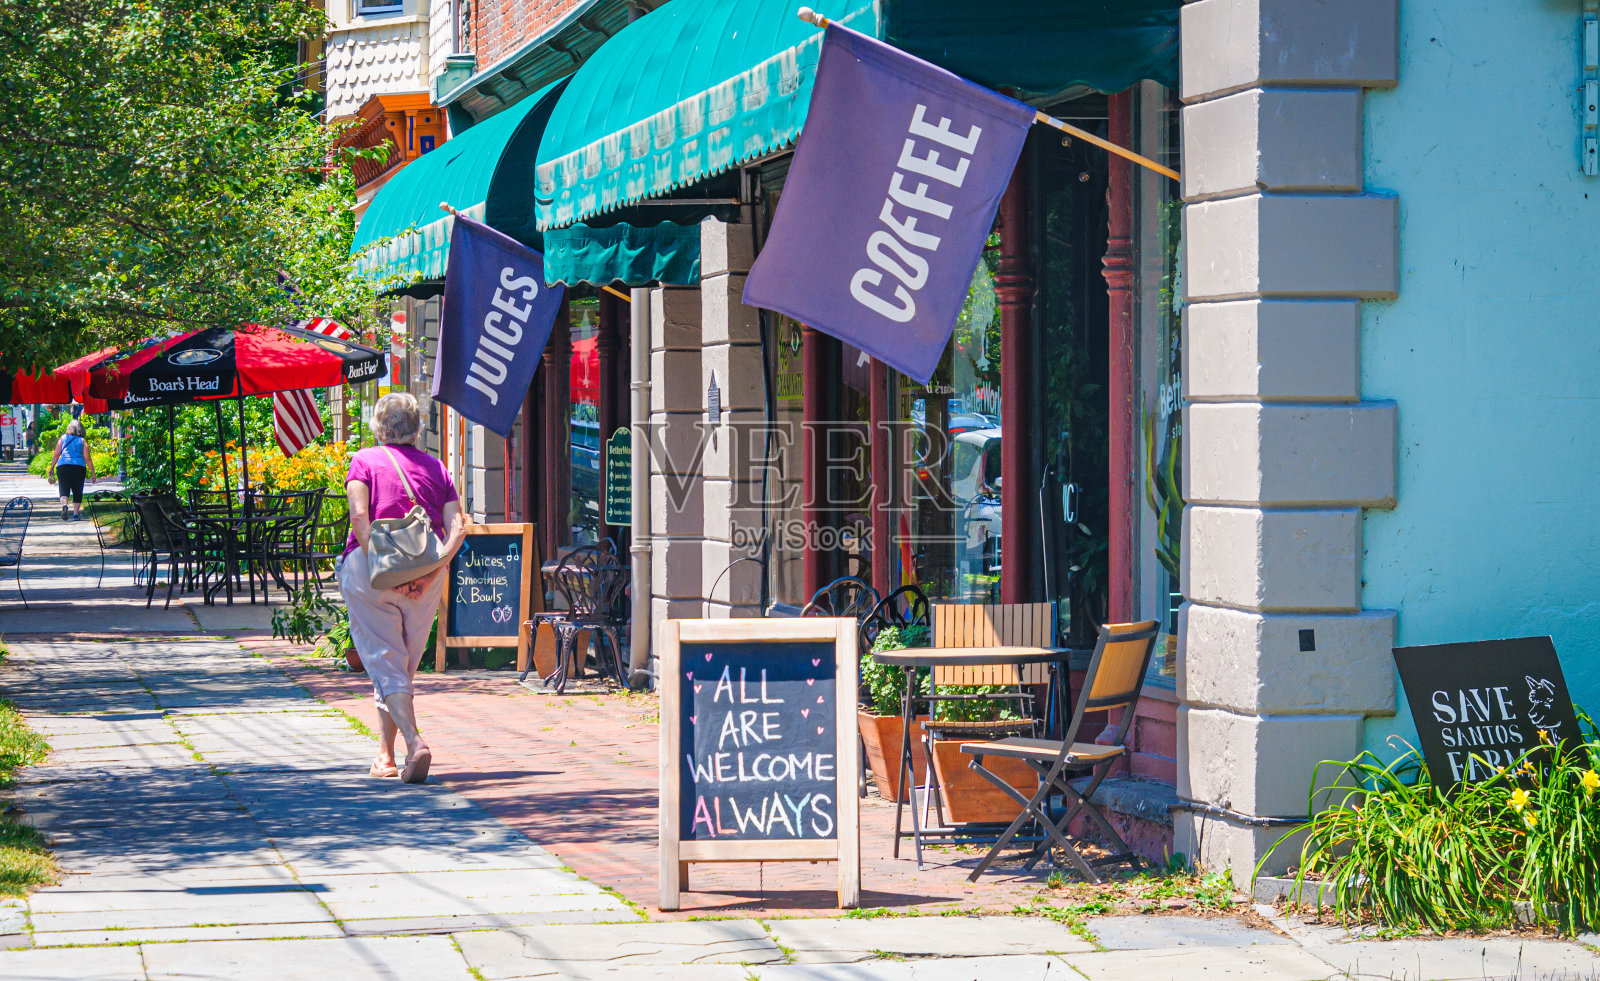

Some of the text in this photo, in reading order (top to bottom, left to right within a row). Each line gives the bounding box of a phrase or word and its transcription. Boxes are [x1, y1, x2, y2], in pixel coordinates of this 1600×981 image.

[850, 103, 982, 322] COFFEE
[465, 266, 539, 406] JUICES
[148, 375, 220, 392] Boar's Head
[348, 361, 364, 379] Boar's
[1160, 371, 1183, 420] Bett
[465, 550, 506, 569] Juices,
[456, 570, 508, 587] Smoothies,
[456, 586, 503, 605] & Bowls
[713, 665, 785, 704] ALL
[1431, 686, 1517, 724] SAVE
[718, 710, 783, 750] ARE
[1441, 724, 1524, 748] SANTOS
[686, 751, 836, 784] WELCOME
[691, 791, 834, 838] ALWAYS
